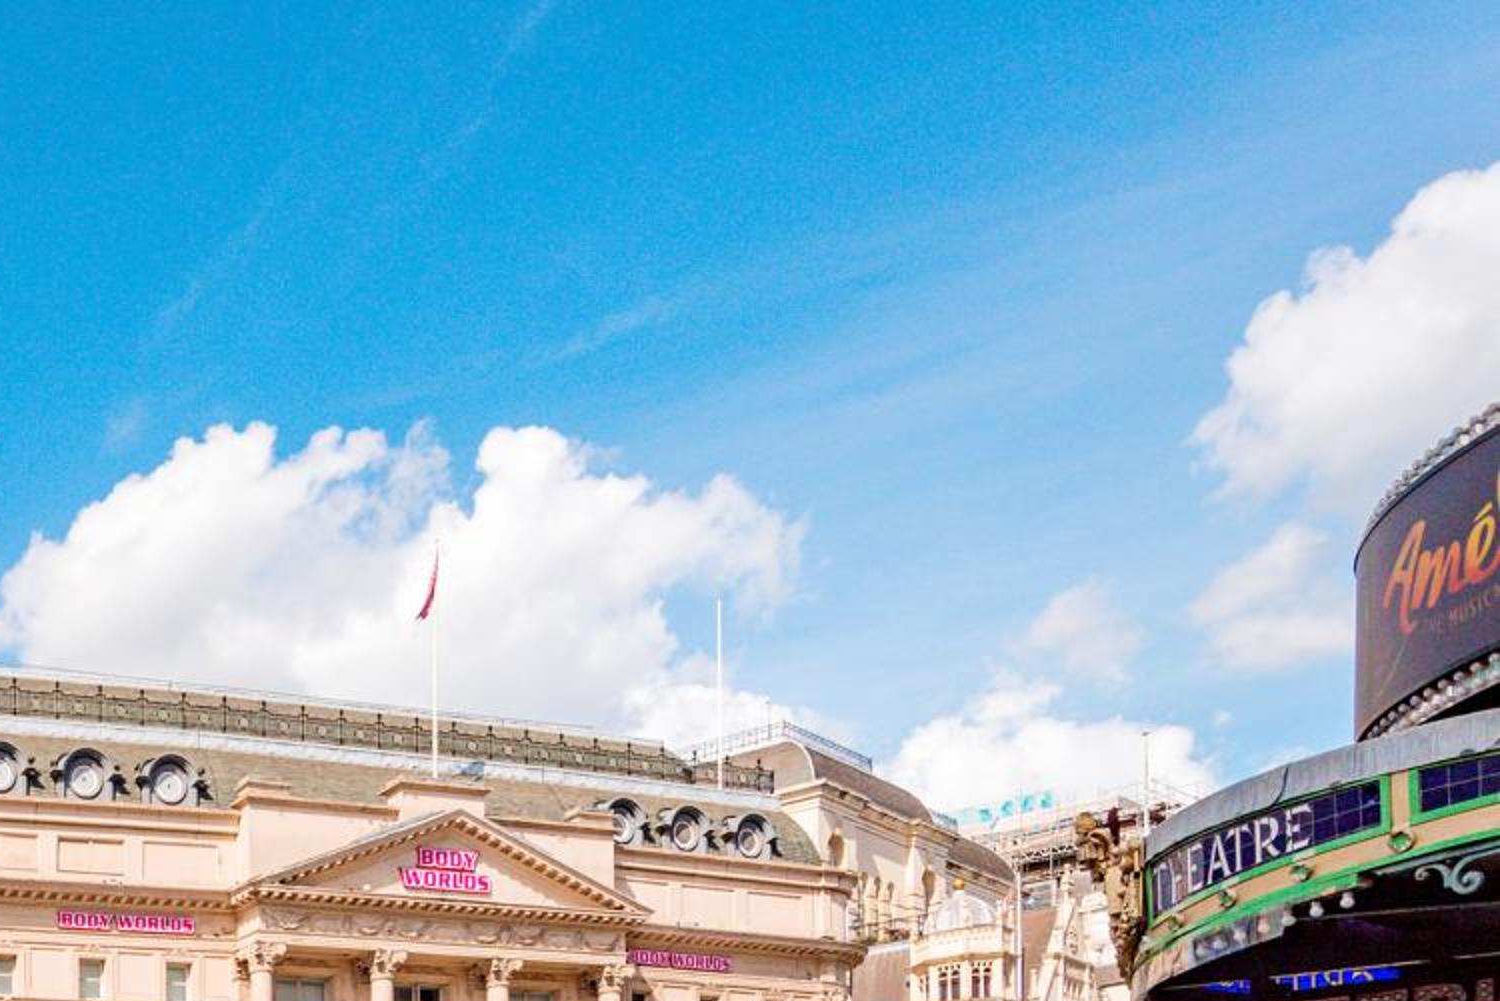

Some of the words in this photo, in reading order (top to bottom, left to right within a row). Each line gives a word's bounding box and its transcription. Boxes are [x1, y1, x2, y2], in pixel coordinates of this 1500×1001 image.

[1383, 500, 1500, 635] Amé
[418, 847, 479, 872] BODY
[1155, 803, 1314, 910] THEATRE
[403, 868, 492, 893] WORLDS
[117, 913, 196, 935] WORLDS
